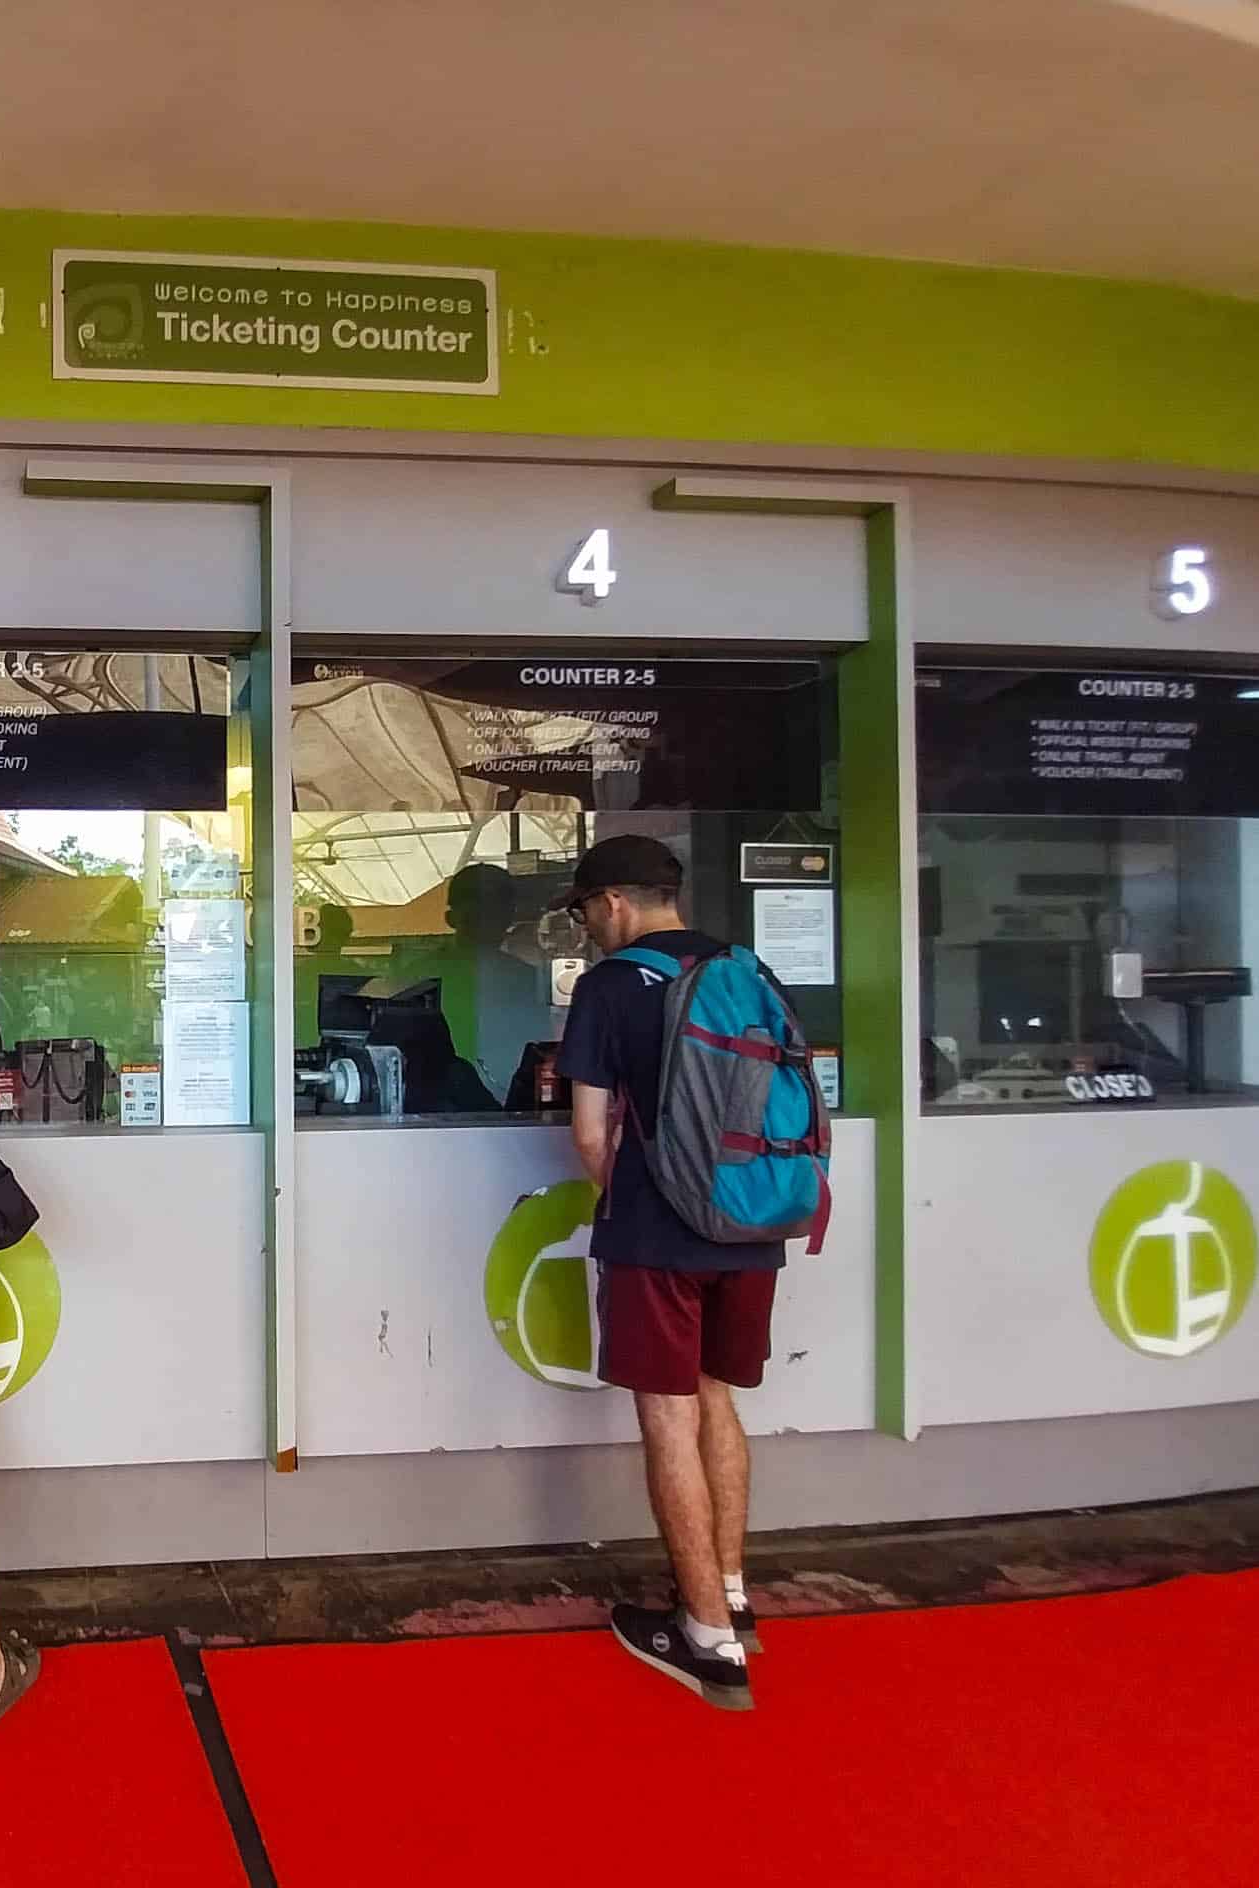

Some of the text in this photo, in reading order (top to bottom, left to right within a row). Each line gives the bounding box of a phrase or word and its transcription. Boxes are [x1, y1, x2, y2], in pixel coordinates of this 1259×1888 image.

[154, 282, 269, 305] Welcome
[325, 289, 472, 315] Happiness
[156, 311, 321, 353] Ticketing
[331, 318, 474, 353] Counter
[567, 528, 617, 598] 4
[1168, 549, 1210, 615] 5
[10, 661, 45, 679] 2-5
[519, 667, 656, 685] COUNTER 2-5
[1078, 679, 1195, 699] COUNTER 2-5
[473, 711, 510, 723] WALK
[608, 711, 659, 725] GROUP)
[473, 727, 529, 739] OFFICIAL
[591, 727, 651, 739] BOOKING
[473, 743, 524, 755] ONLINE
[576, 744, 621, 755] AGENT
[474, 759, 538, 772] VOUCHER
[539, 759, 592, 773] (TRAVEL
[1065, 1074, 1154, 1099] CLOSED
